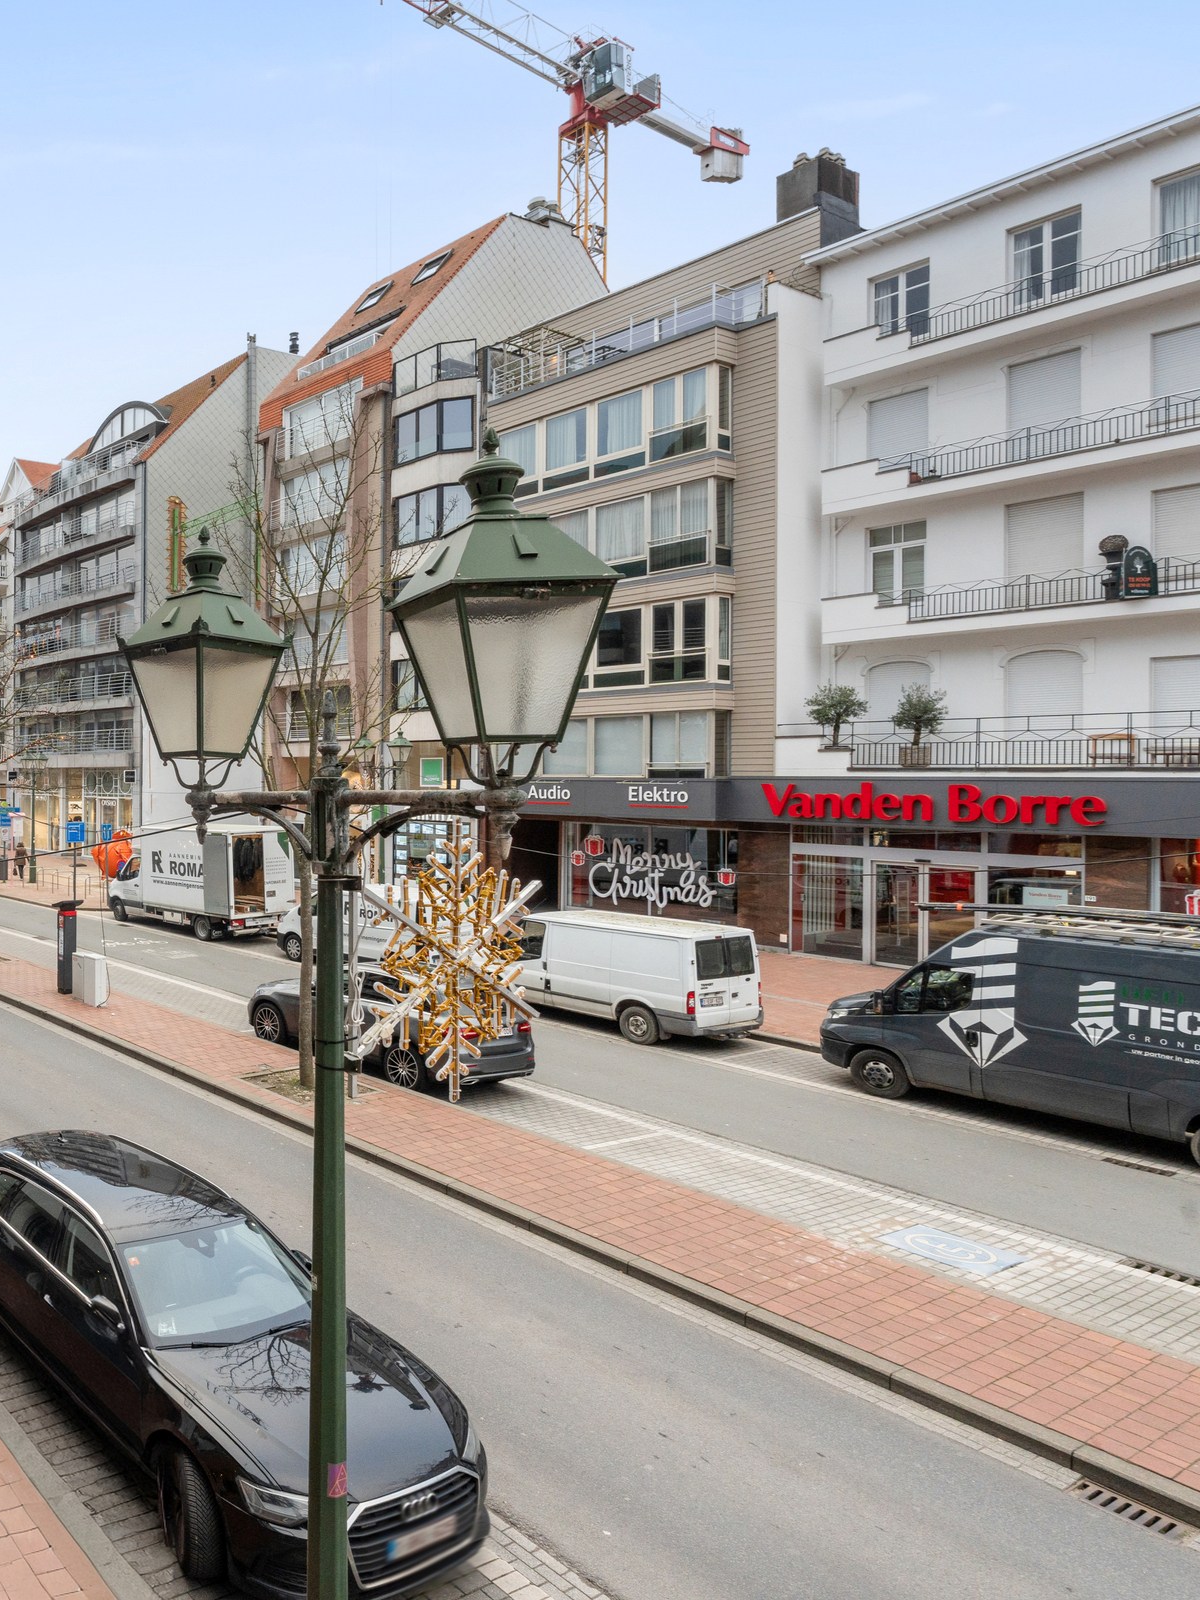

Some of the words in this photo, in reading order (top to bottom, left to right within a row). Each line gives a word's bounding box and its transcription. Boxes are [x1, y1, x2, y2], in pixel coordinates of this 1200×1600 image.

[527, 785, 571, 800] Audio
[628, 786, 689, 803] Elektro
[760, 781, 934, 822] Vanden
[947, 783, 1108, 827] Borre
[609, 837, 702, 887] Merry
[588, 862, 718, 908] Christmas
[1144, 1050, 1174, 1061] partner
